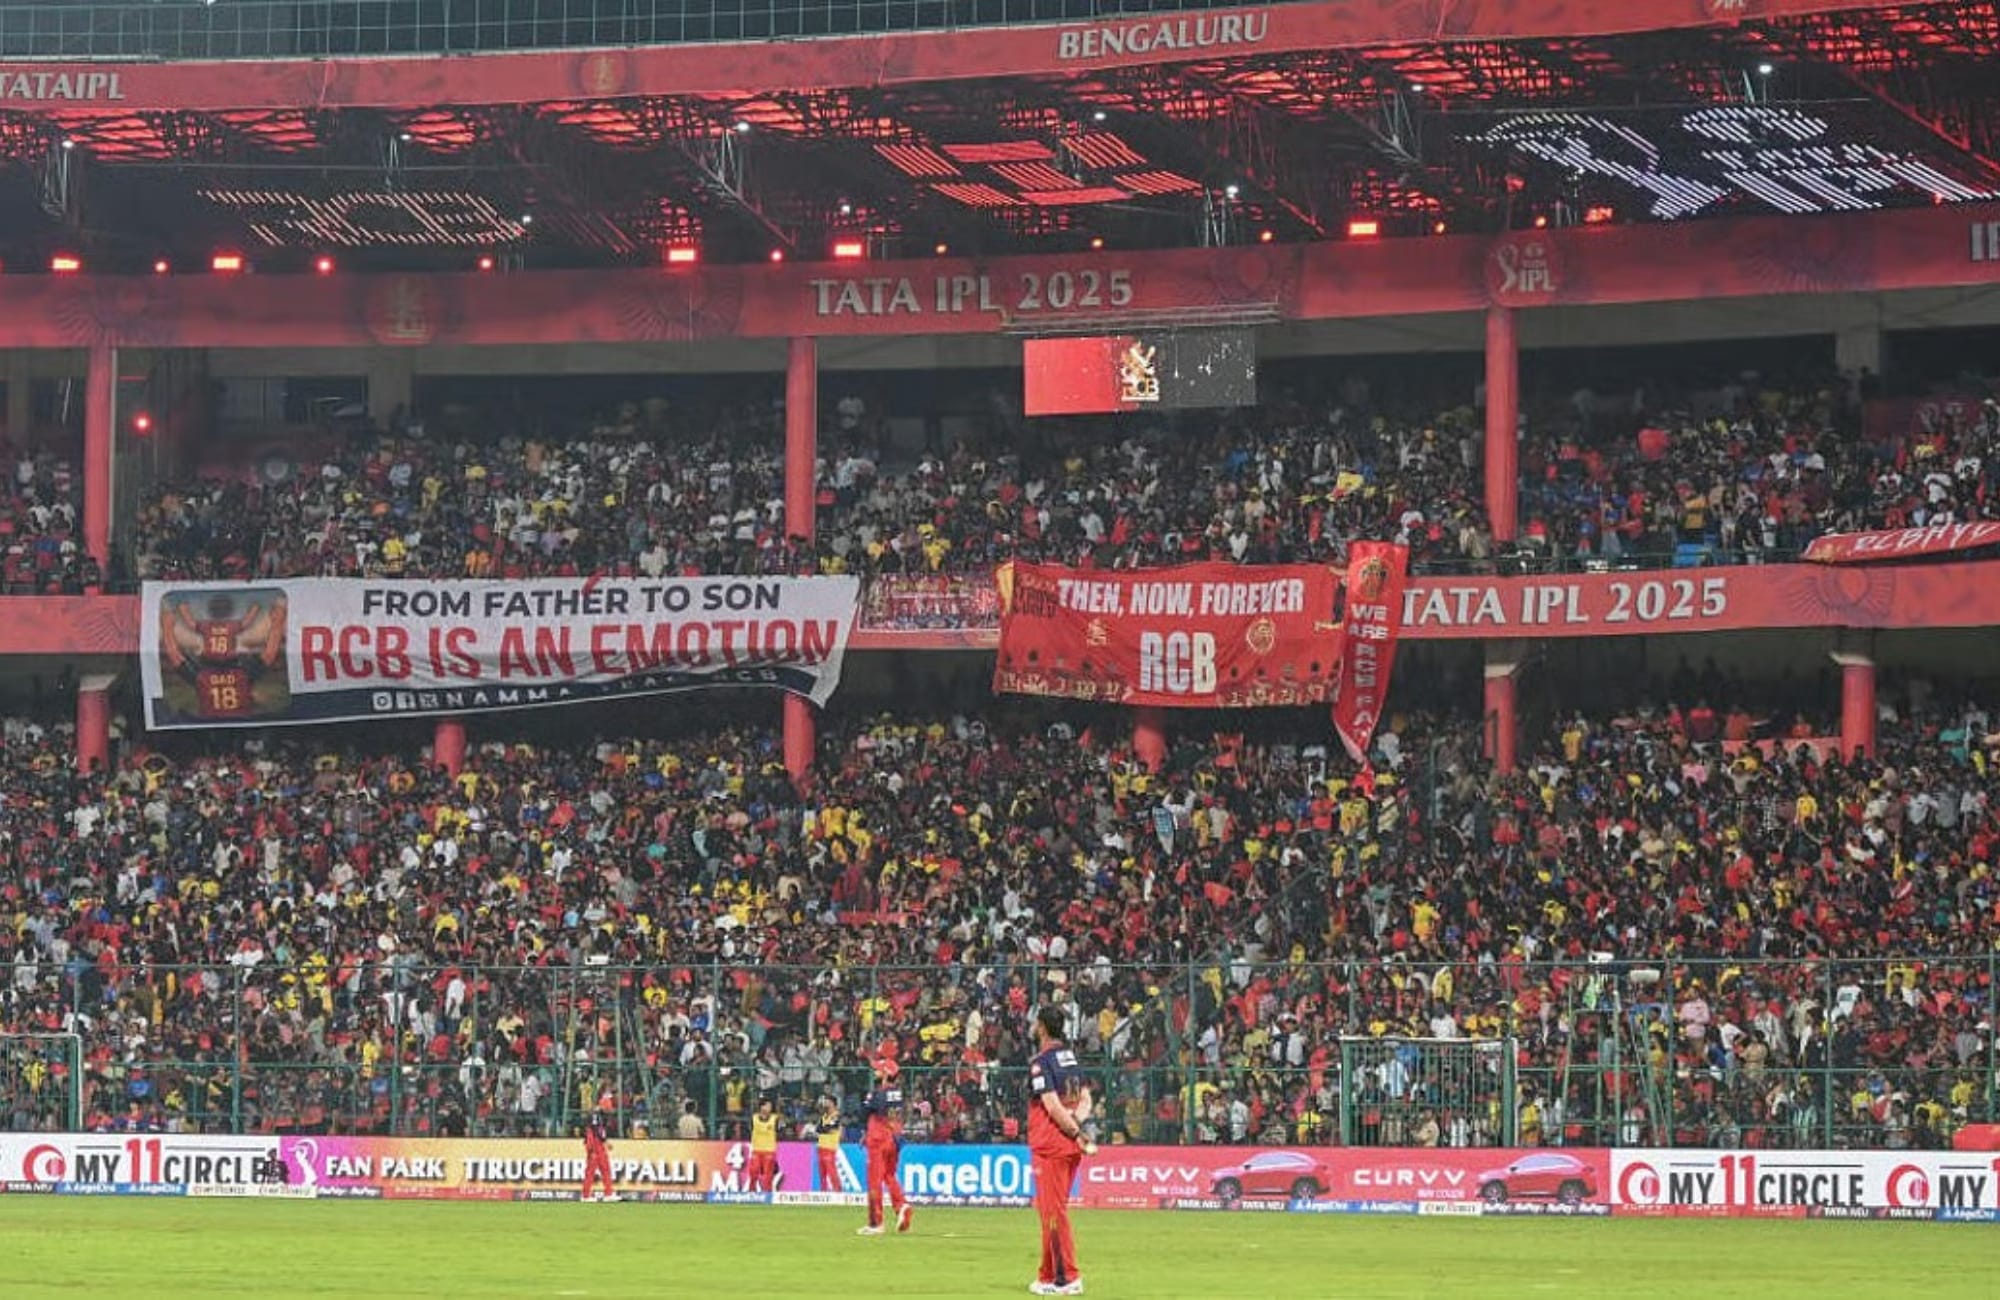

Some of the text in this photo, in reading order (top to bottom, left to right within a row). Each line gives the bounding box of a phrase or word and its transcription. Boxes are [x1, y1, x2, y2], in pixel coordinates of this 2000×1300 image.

[1059, 13, 1269, 60] BENGALURU
[810, 270, 1133, 315] TATA IPL 2025
[1519, 269, 1556, 291] IPL
[362, 583, 781, 617] FROM FATHER TO SON
[1058, 578, 1124, 618] THEN,
[1130, 581, 1195, 618] NOW,
[1200, 578, 1304, 616] FOREVER
[1350, 604, 1387, 621] WE
[1402, 578, 1727, 625] TATA IPL 2025
[209, 636, 228, 653] 18
[301, 619, 838, 681] RCB IS AN EMOTION
[1139, 631, 1217, 694] RCB
[211, 687, 237, 709] 18
[326, 1156, 696, 1184] FAN PARK TIRUCHIRPPALLI
[1088, 1167, 1200, 1183] CURVV
[1353, 1169, 1466, 1185] CURVV
